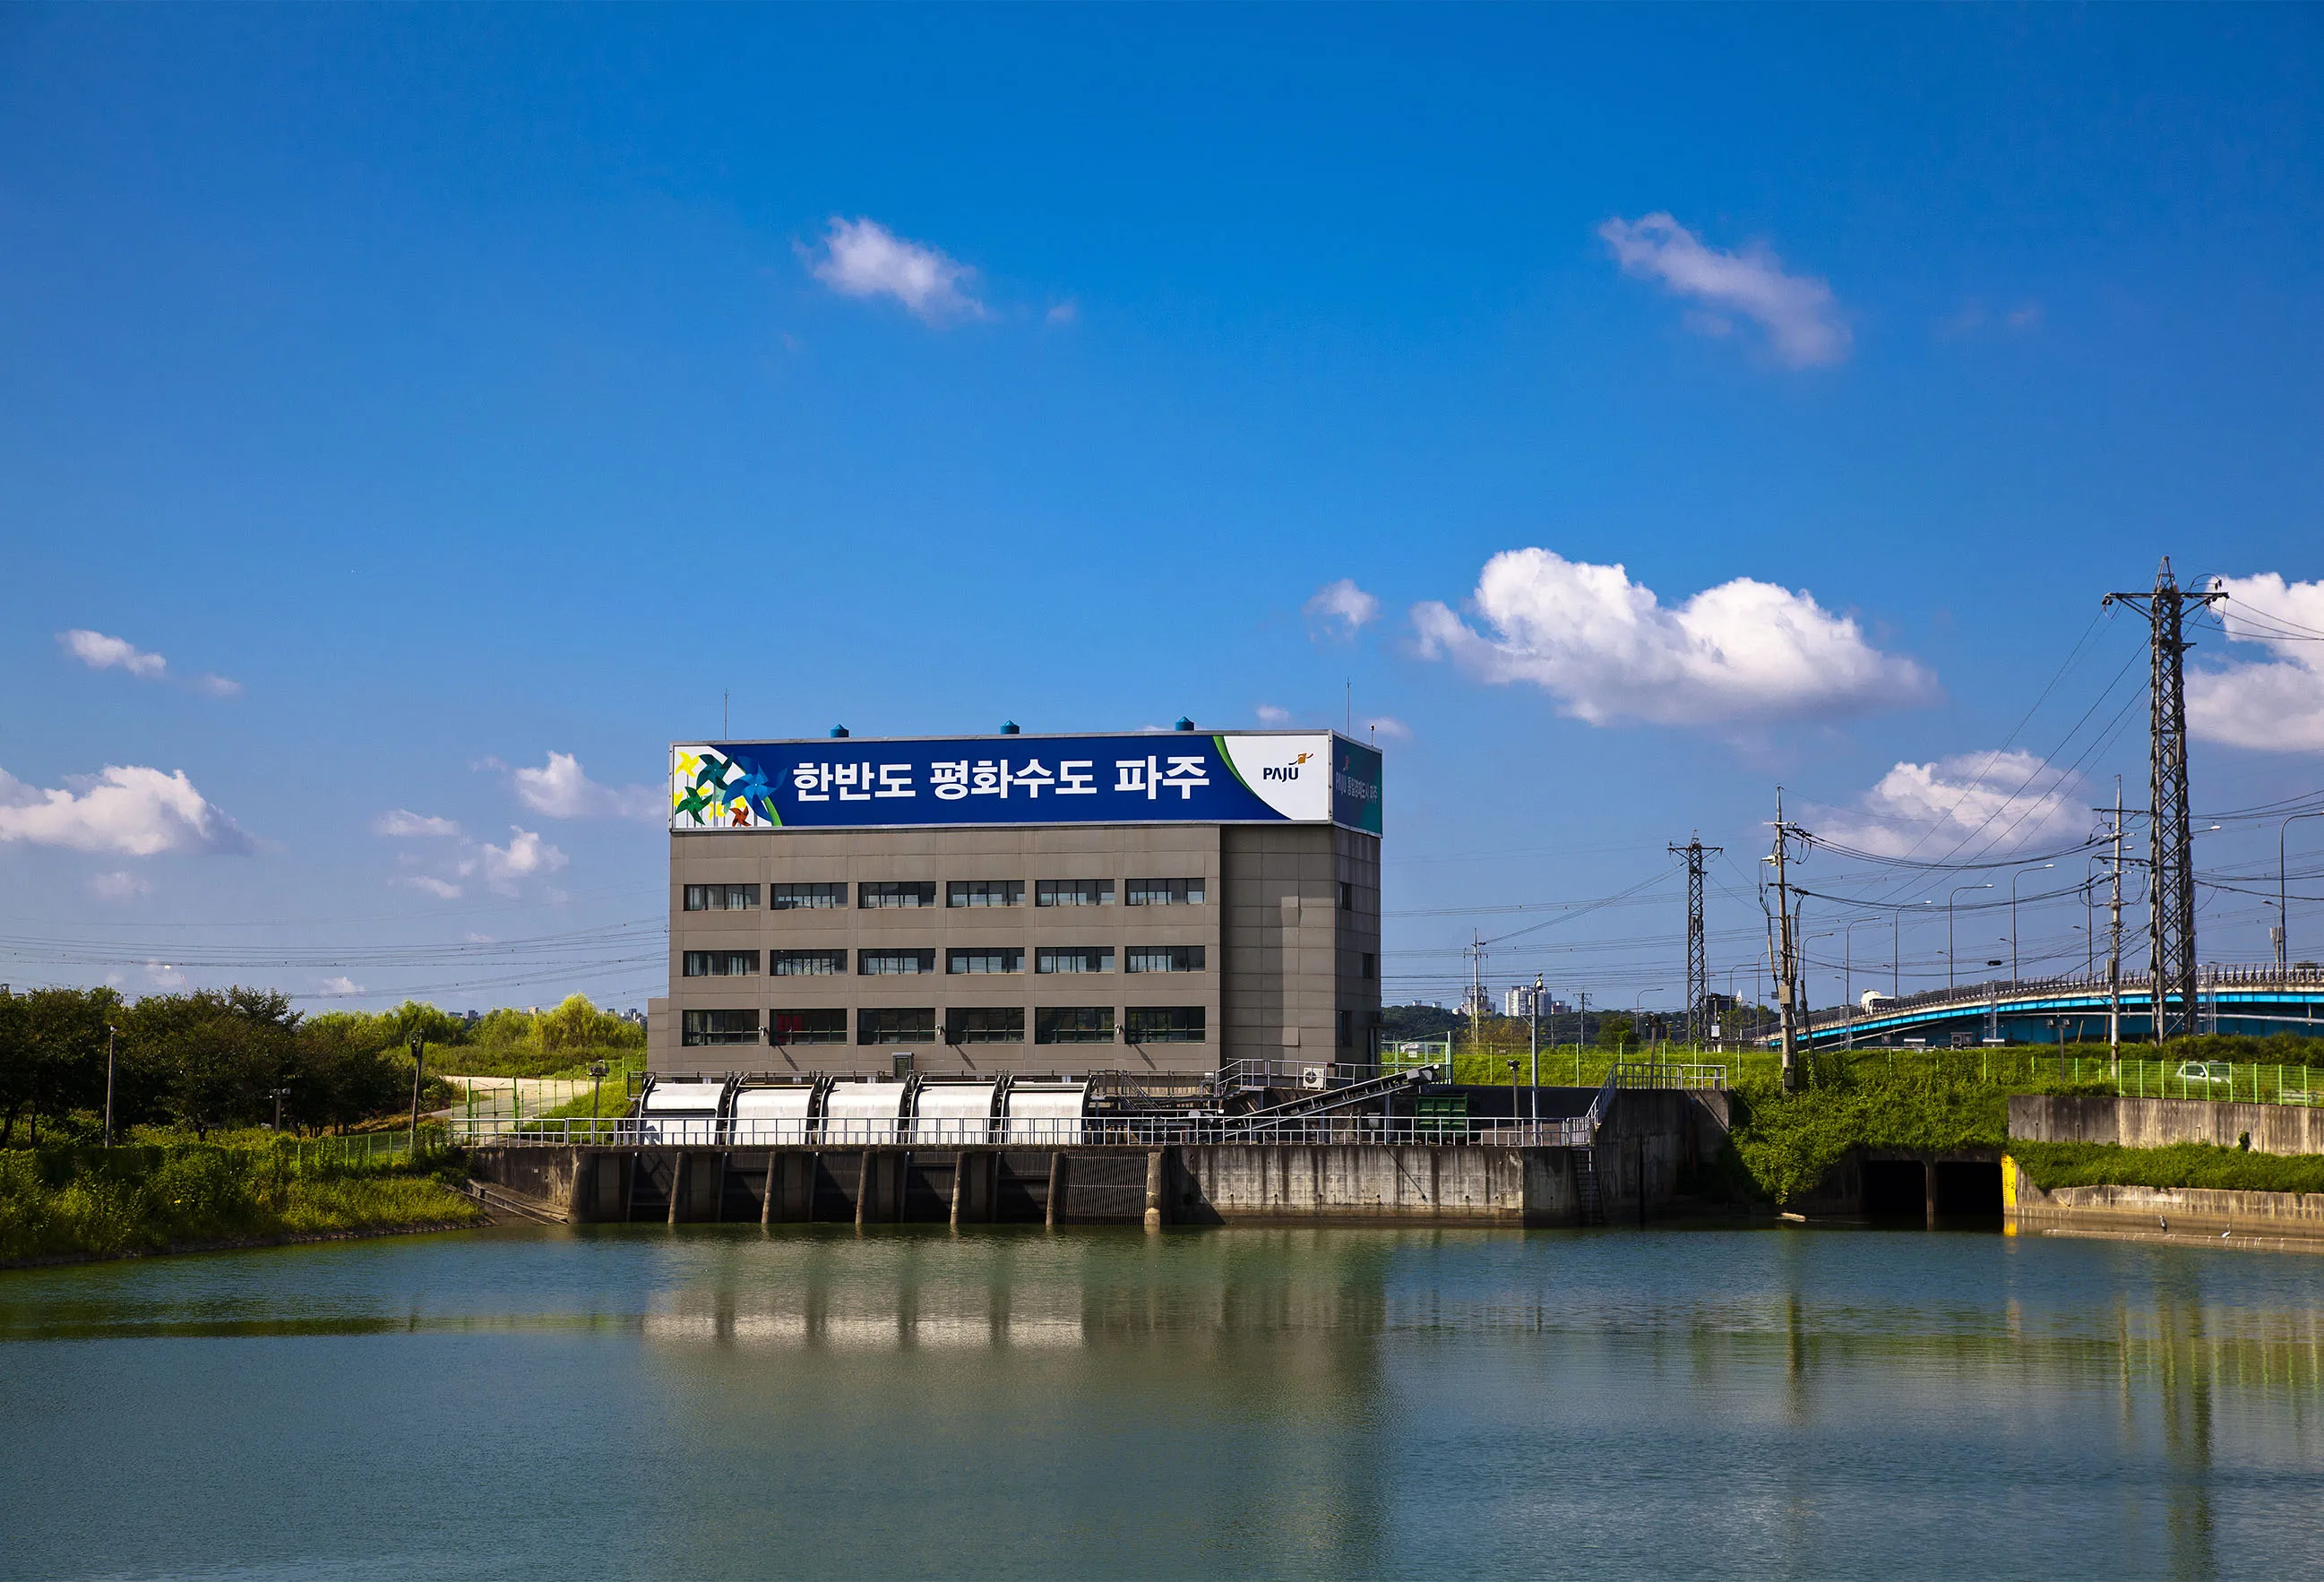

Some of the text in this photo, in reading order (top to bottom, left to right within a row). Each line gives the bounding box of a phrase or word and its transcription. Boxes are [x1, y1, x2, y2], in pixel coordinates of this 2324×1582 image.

[794, 755, 1210, 802] 한반도 평화수도 파주
[1263, 767, 1299, 783] PAJU
